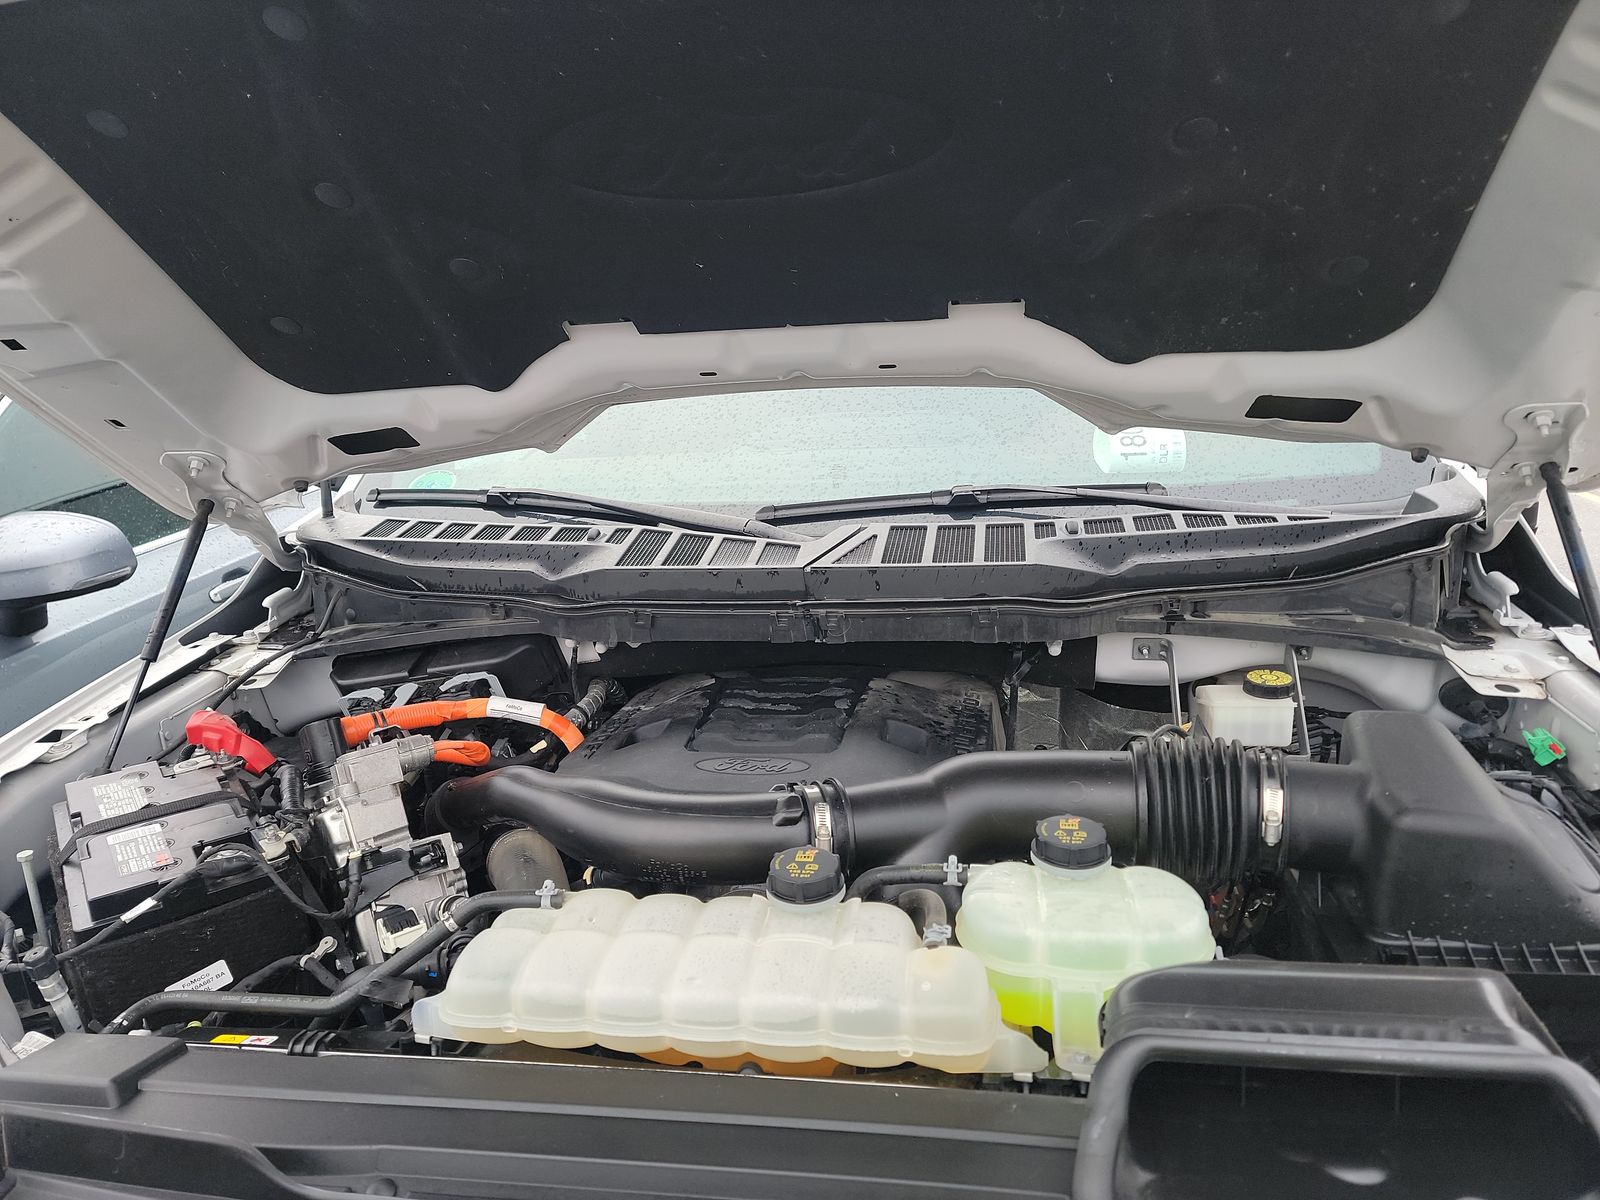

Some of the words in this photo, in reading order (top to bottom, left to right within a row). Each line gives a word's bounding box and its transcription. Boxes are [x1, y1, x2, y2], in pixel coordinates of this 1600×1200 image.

[1159, 443, 1168, 464] DLR
[713, 757, 793, 773] Ford
[182, 972, 211, 989] FoMoCo
